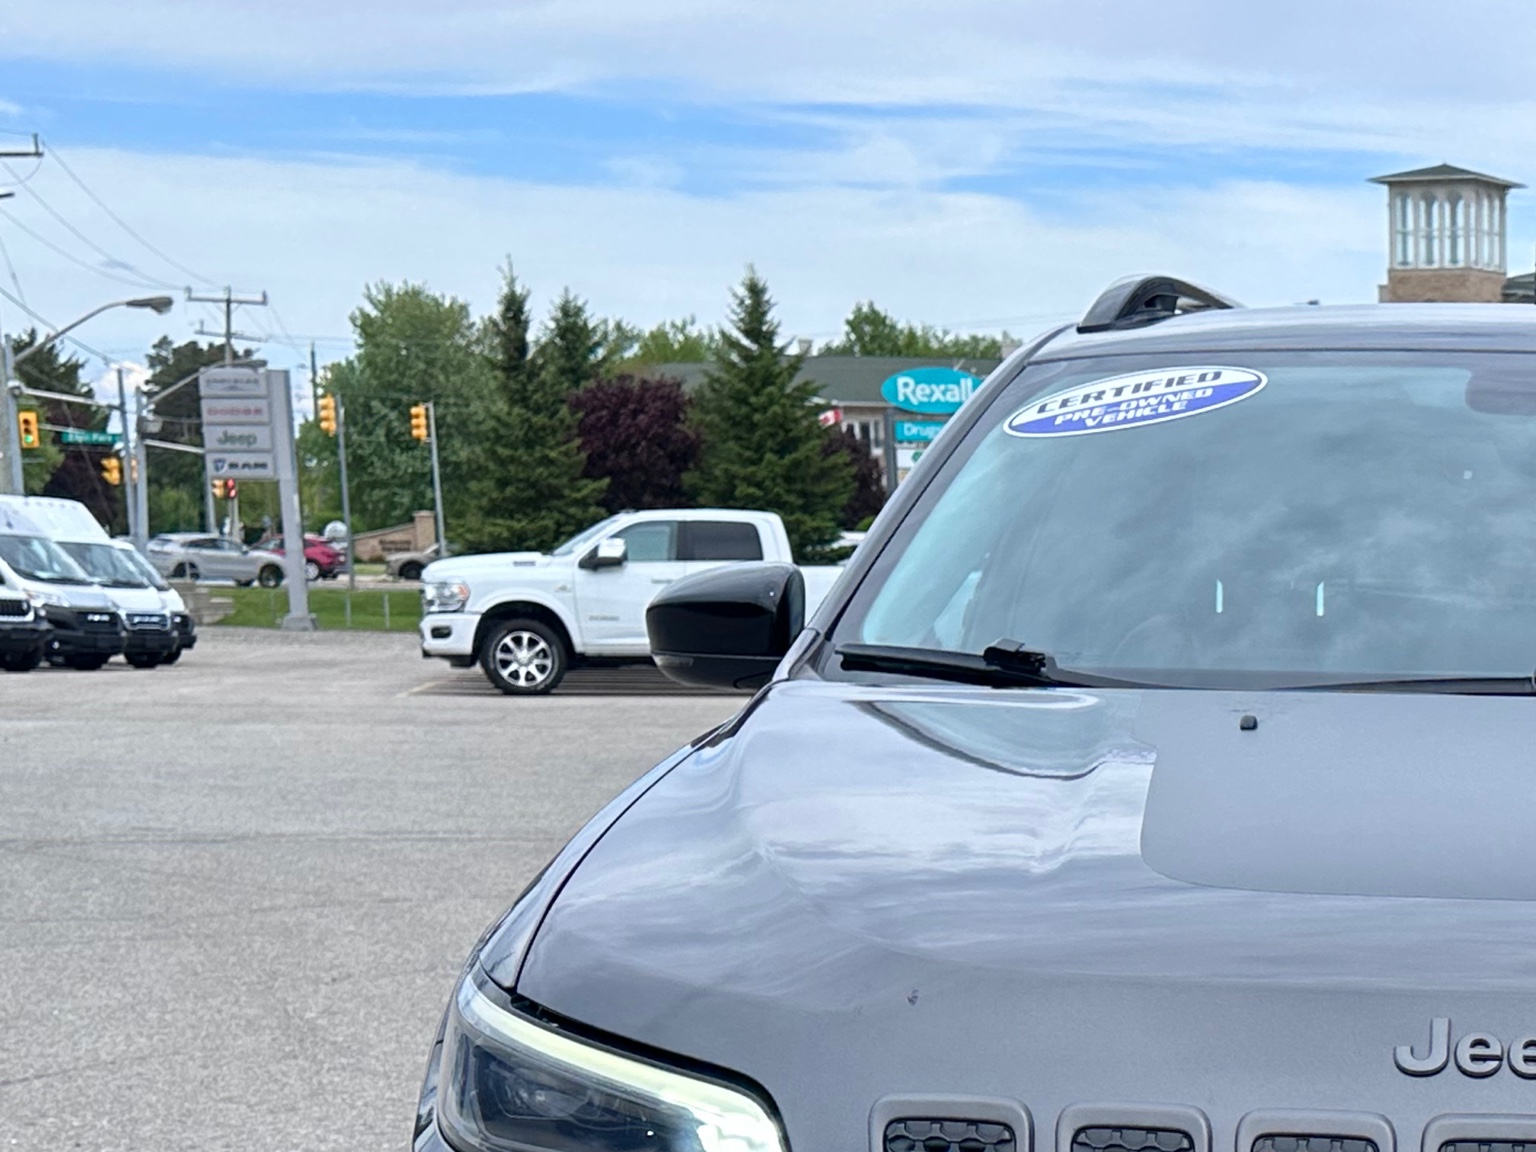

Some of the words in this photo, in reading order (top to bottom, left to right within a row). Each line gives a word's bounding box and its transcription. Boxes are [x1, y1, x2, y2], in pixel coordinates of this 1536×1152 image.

[896, 376, 974, 405] Rexall
[1037, 371, 1223, 414] CERTIFIED
[1054, 388, 1214, 425] PRE-OWNED
[1085, 400, 1188, 428] VEHICLE
[216, 430, 258, 448] Jeep
